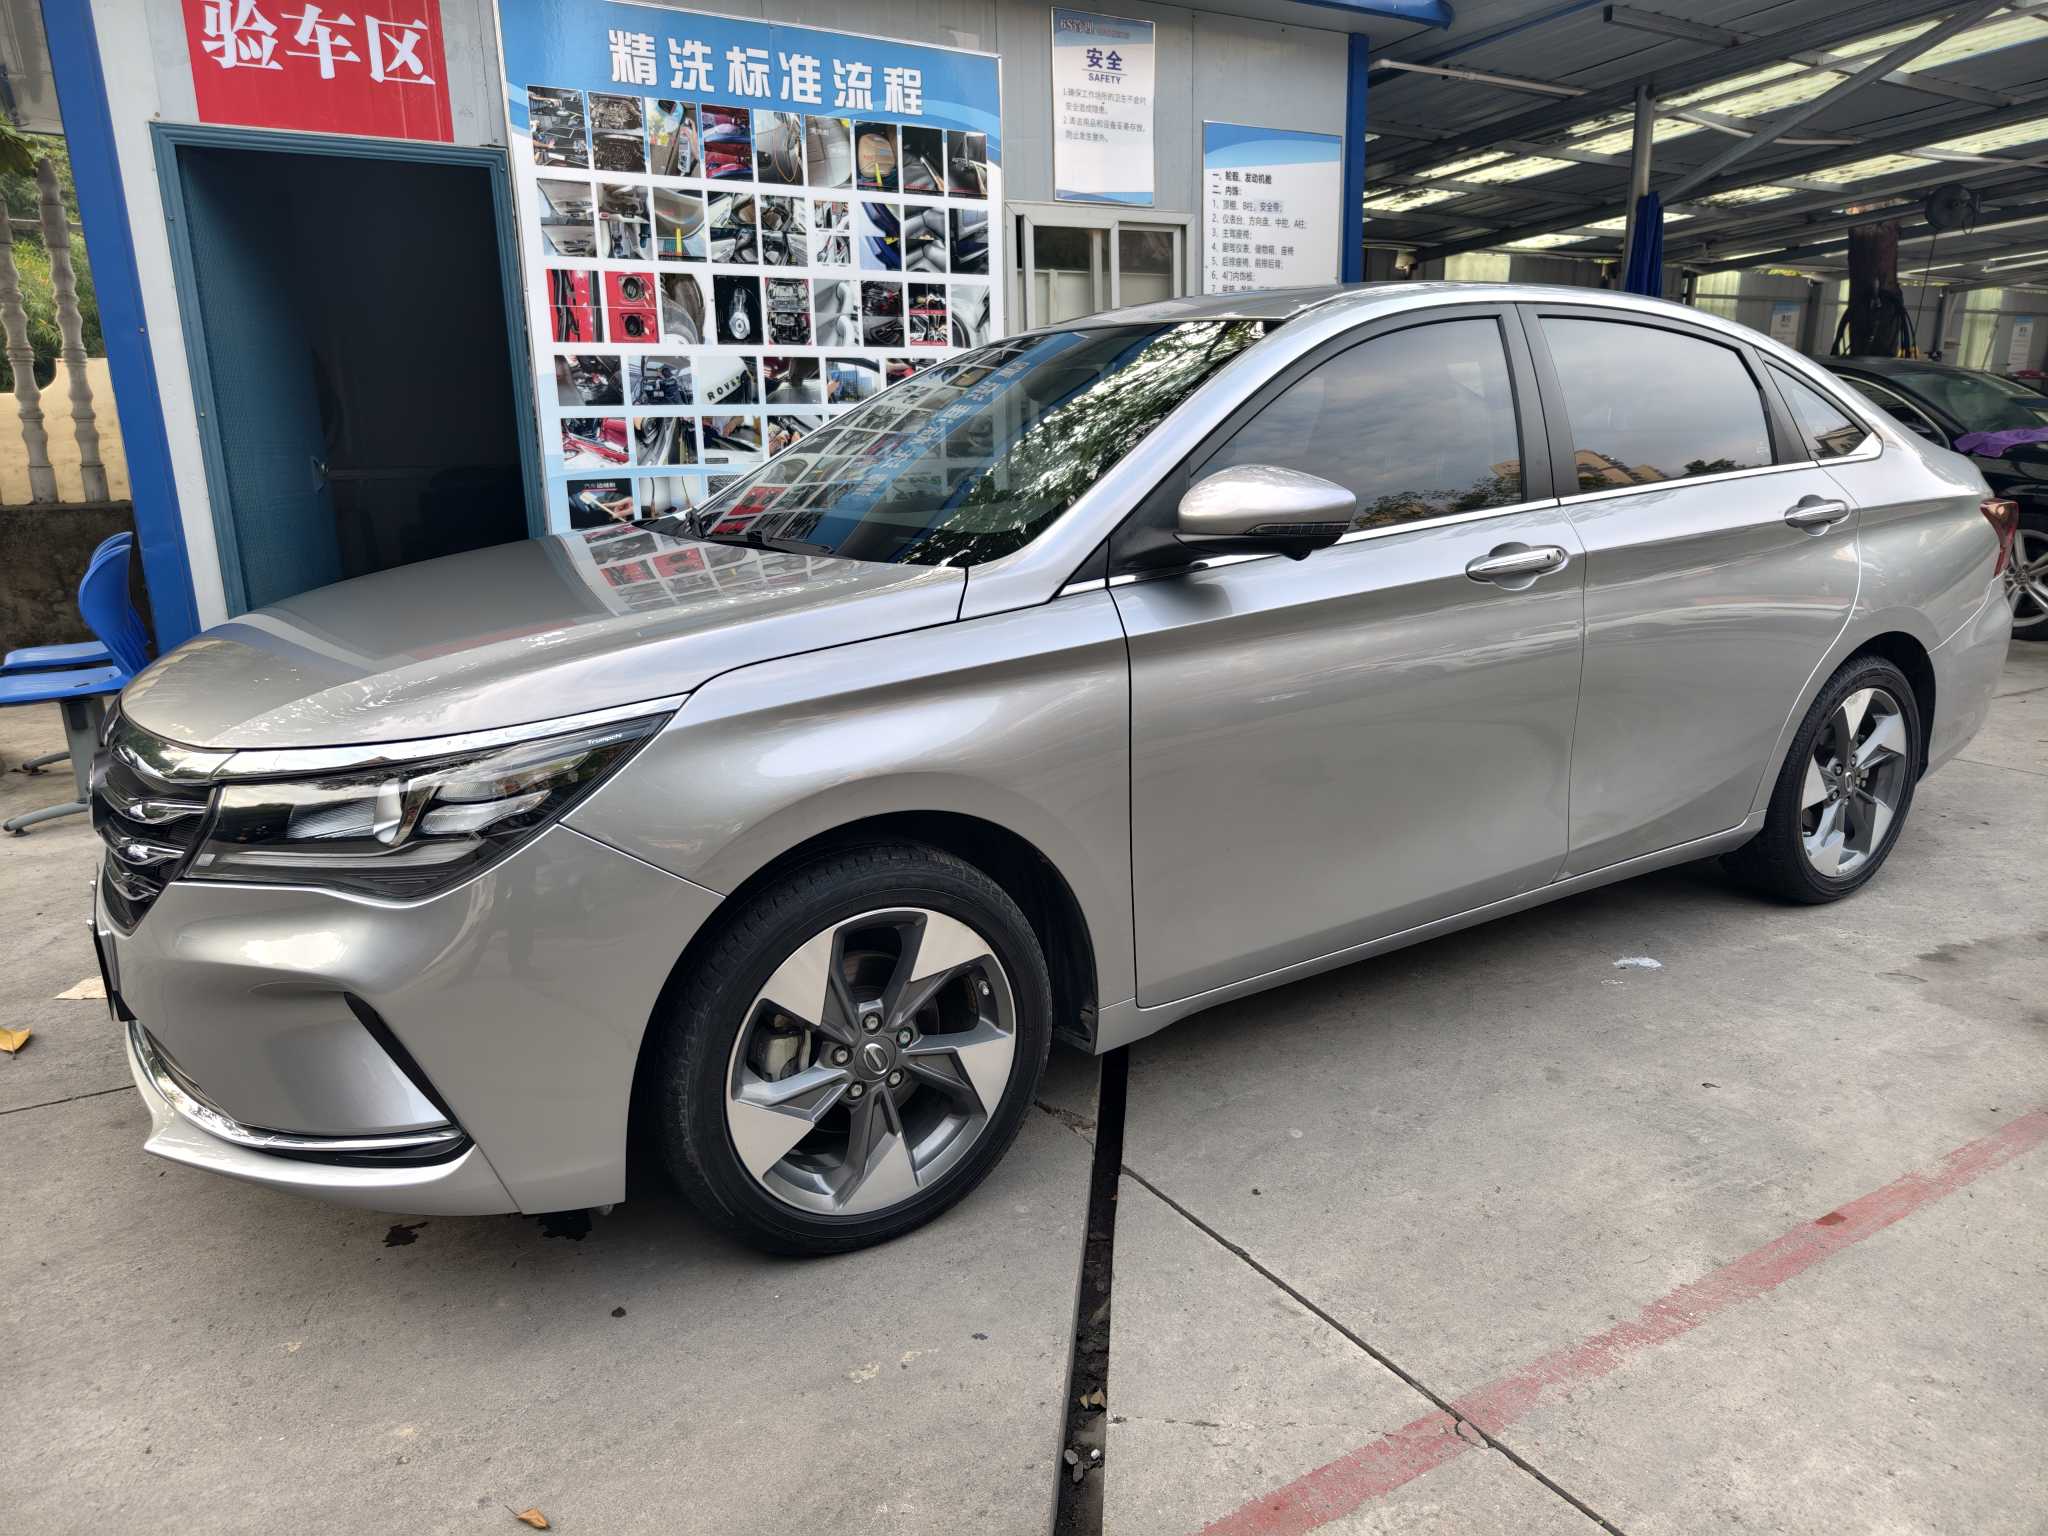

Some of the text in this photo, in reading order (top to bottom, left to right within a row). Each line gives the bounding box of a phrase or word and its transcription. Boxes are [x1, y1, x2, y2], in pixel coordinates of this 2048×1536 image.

[201, 0, 436, 85] 验车区
[1086, 47, 1123, 71] 安全
[608, 29, 923, 116] 精洗标准流程
[1088, 72, 1122, 85] SAFETY
